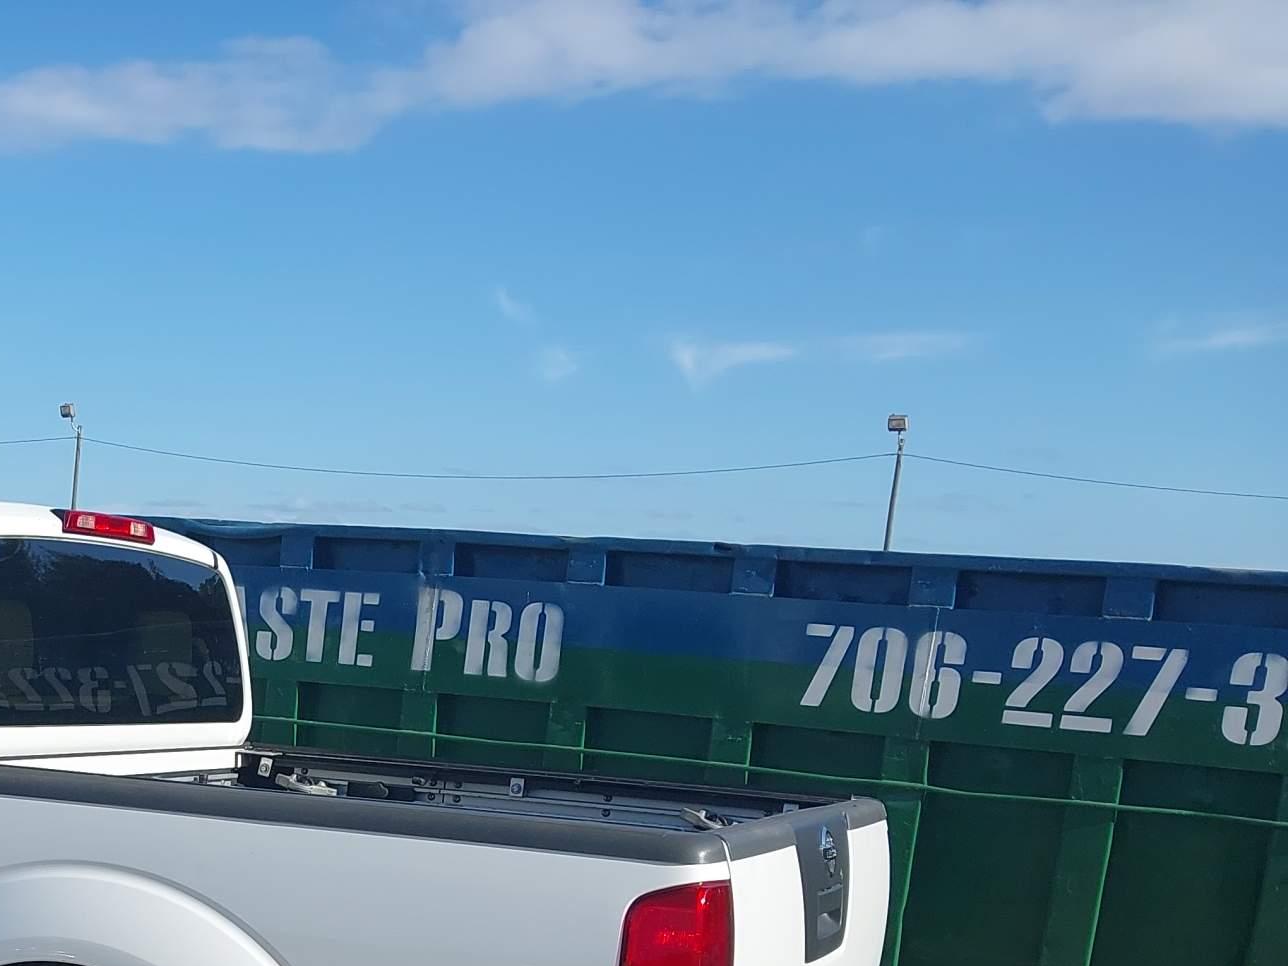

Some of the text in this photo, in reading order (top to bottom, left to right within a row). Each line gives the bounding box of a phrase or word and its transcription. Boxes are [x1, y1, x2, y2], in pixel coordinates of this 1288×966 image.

[236, 584, 565, 682] STE PRO
[800, 623, 1288, 746] 706-227-3
